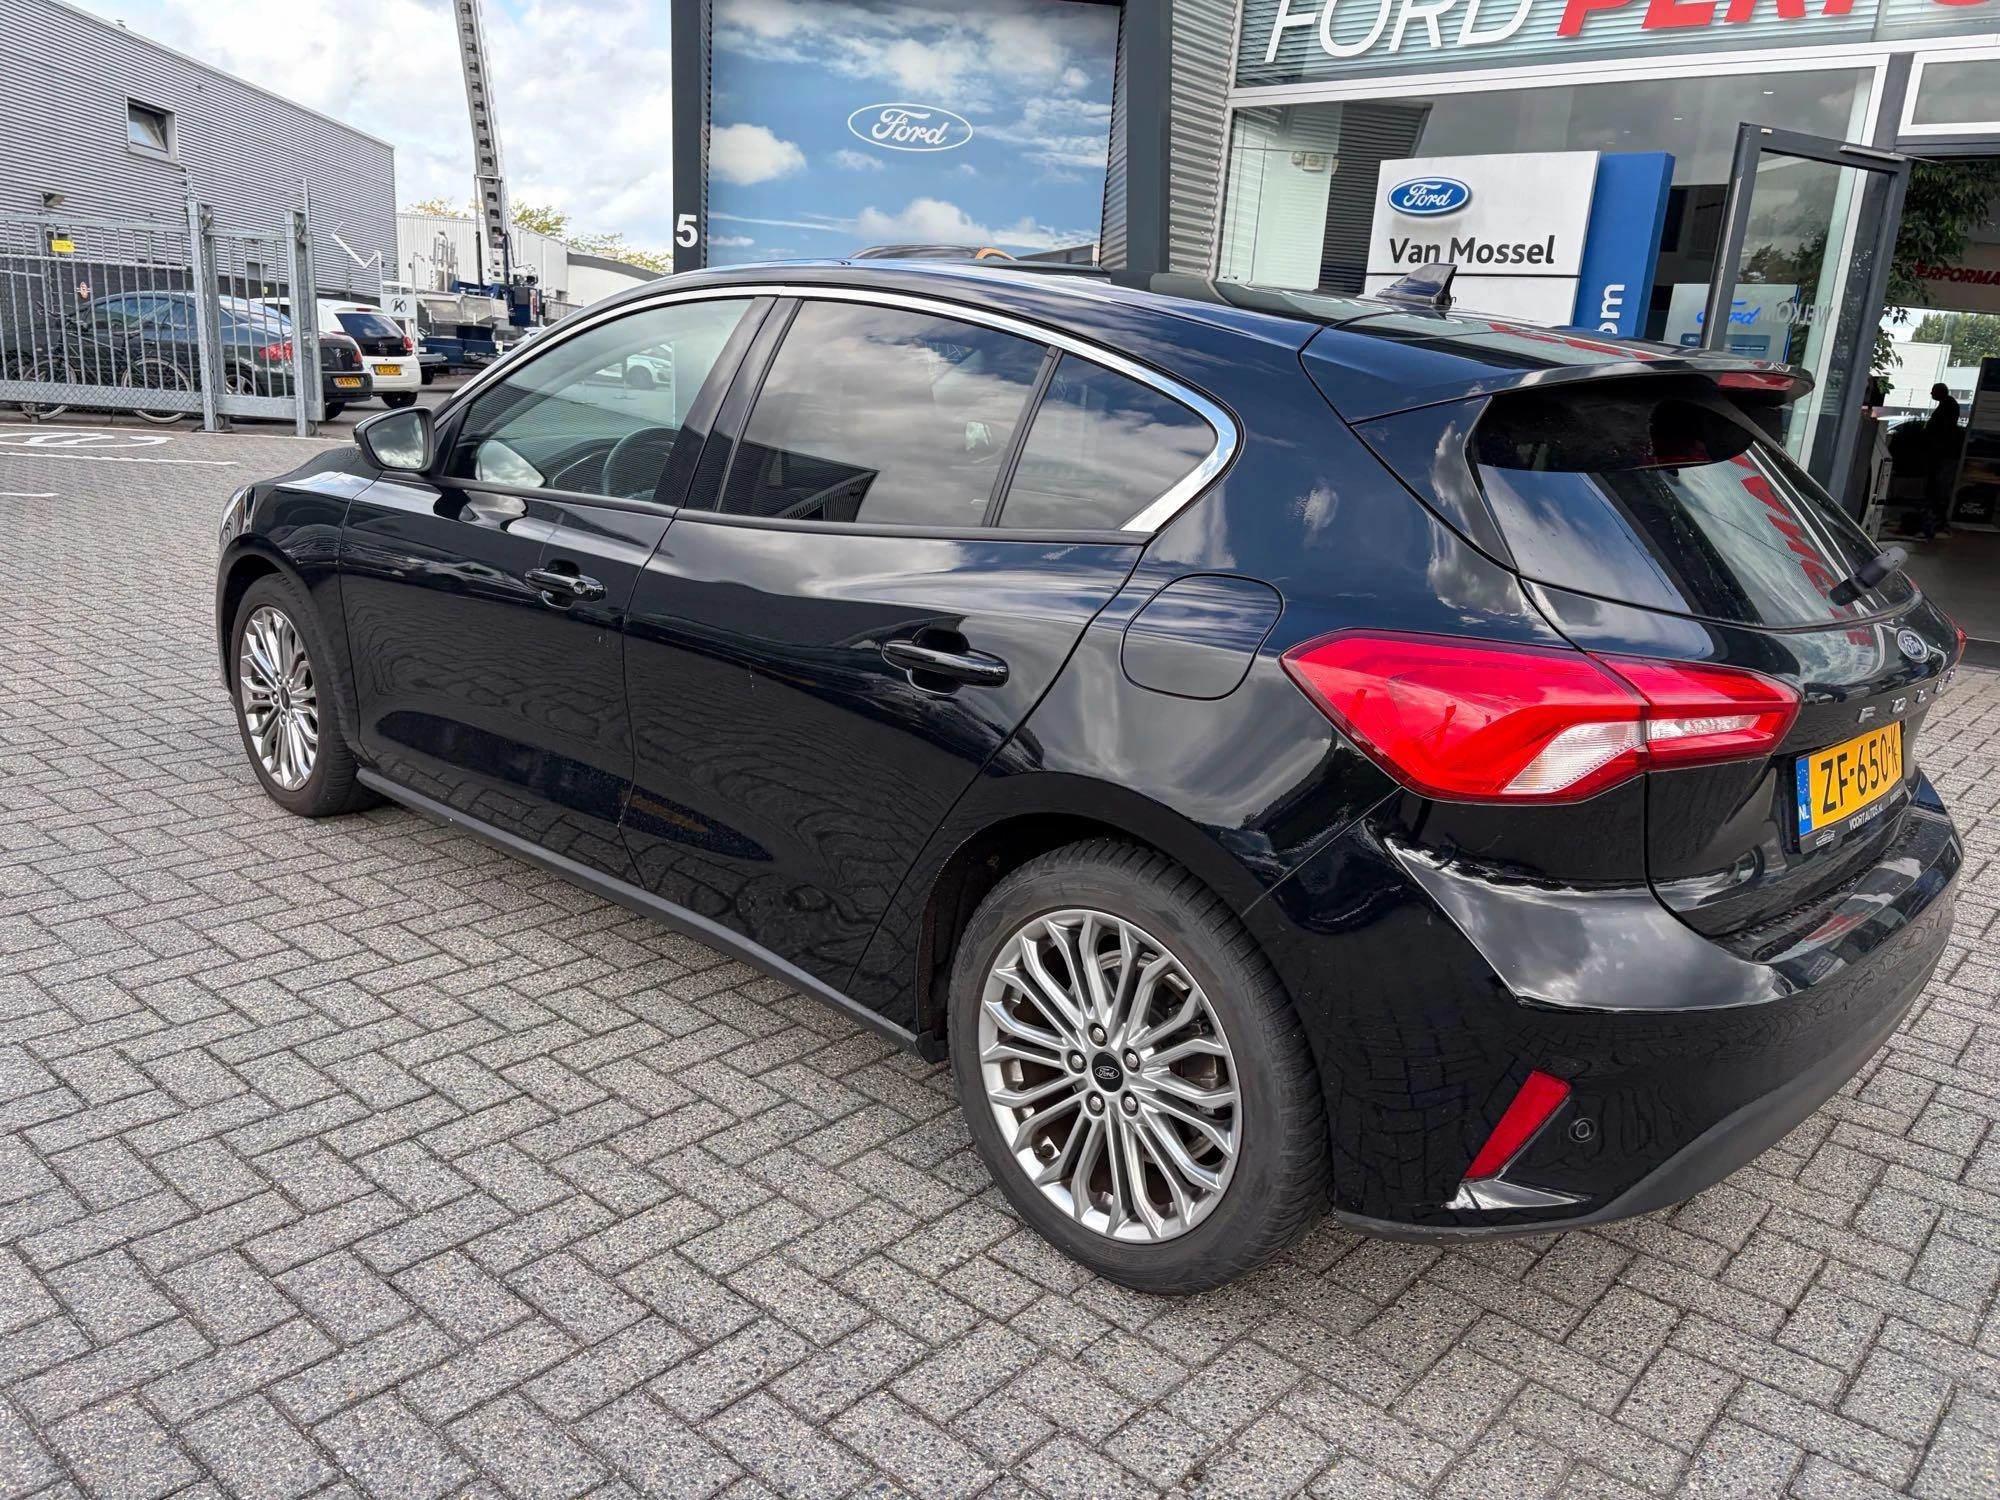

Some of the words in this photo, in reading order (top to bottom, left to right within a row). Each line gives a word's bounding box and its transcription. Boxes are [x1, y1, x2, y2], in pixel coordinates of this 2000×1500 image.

[872, 108, 950, 145] Ford
[1403, 183, 1453, 207] Ford
[676, 213, 699, 248] 5
[1389, 238, 1441, 264] Van
[1448, 235, 1556, 265] Mossel
[1820, 725, 1899, 815] ZF-650-K
[1798, 804, 1810, 822] NL
